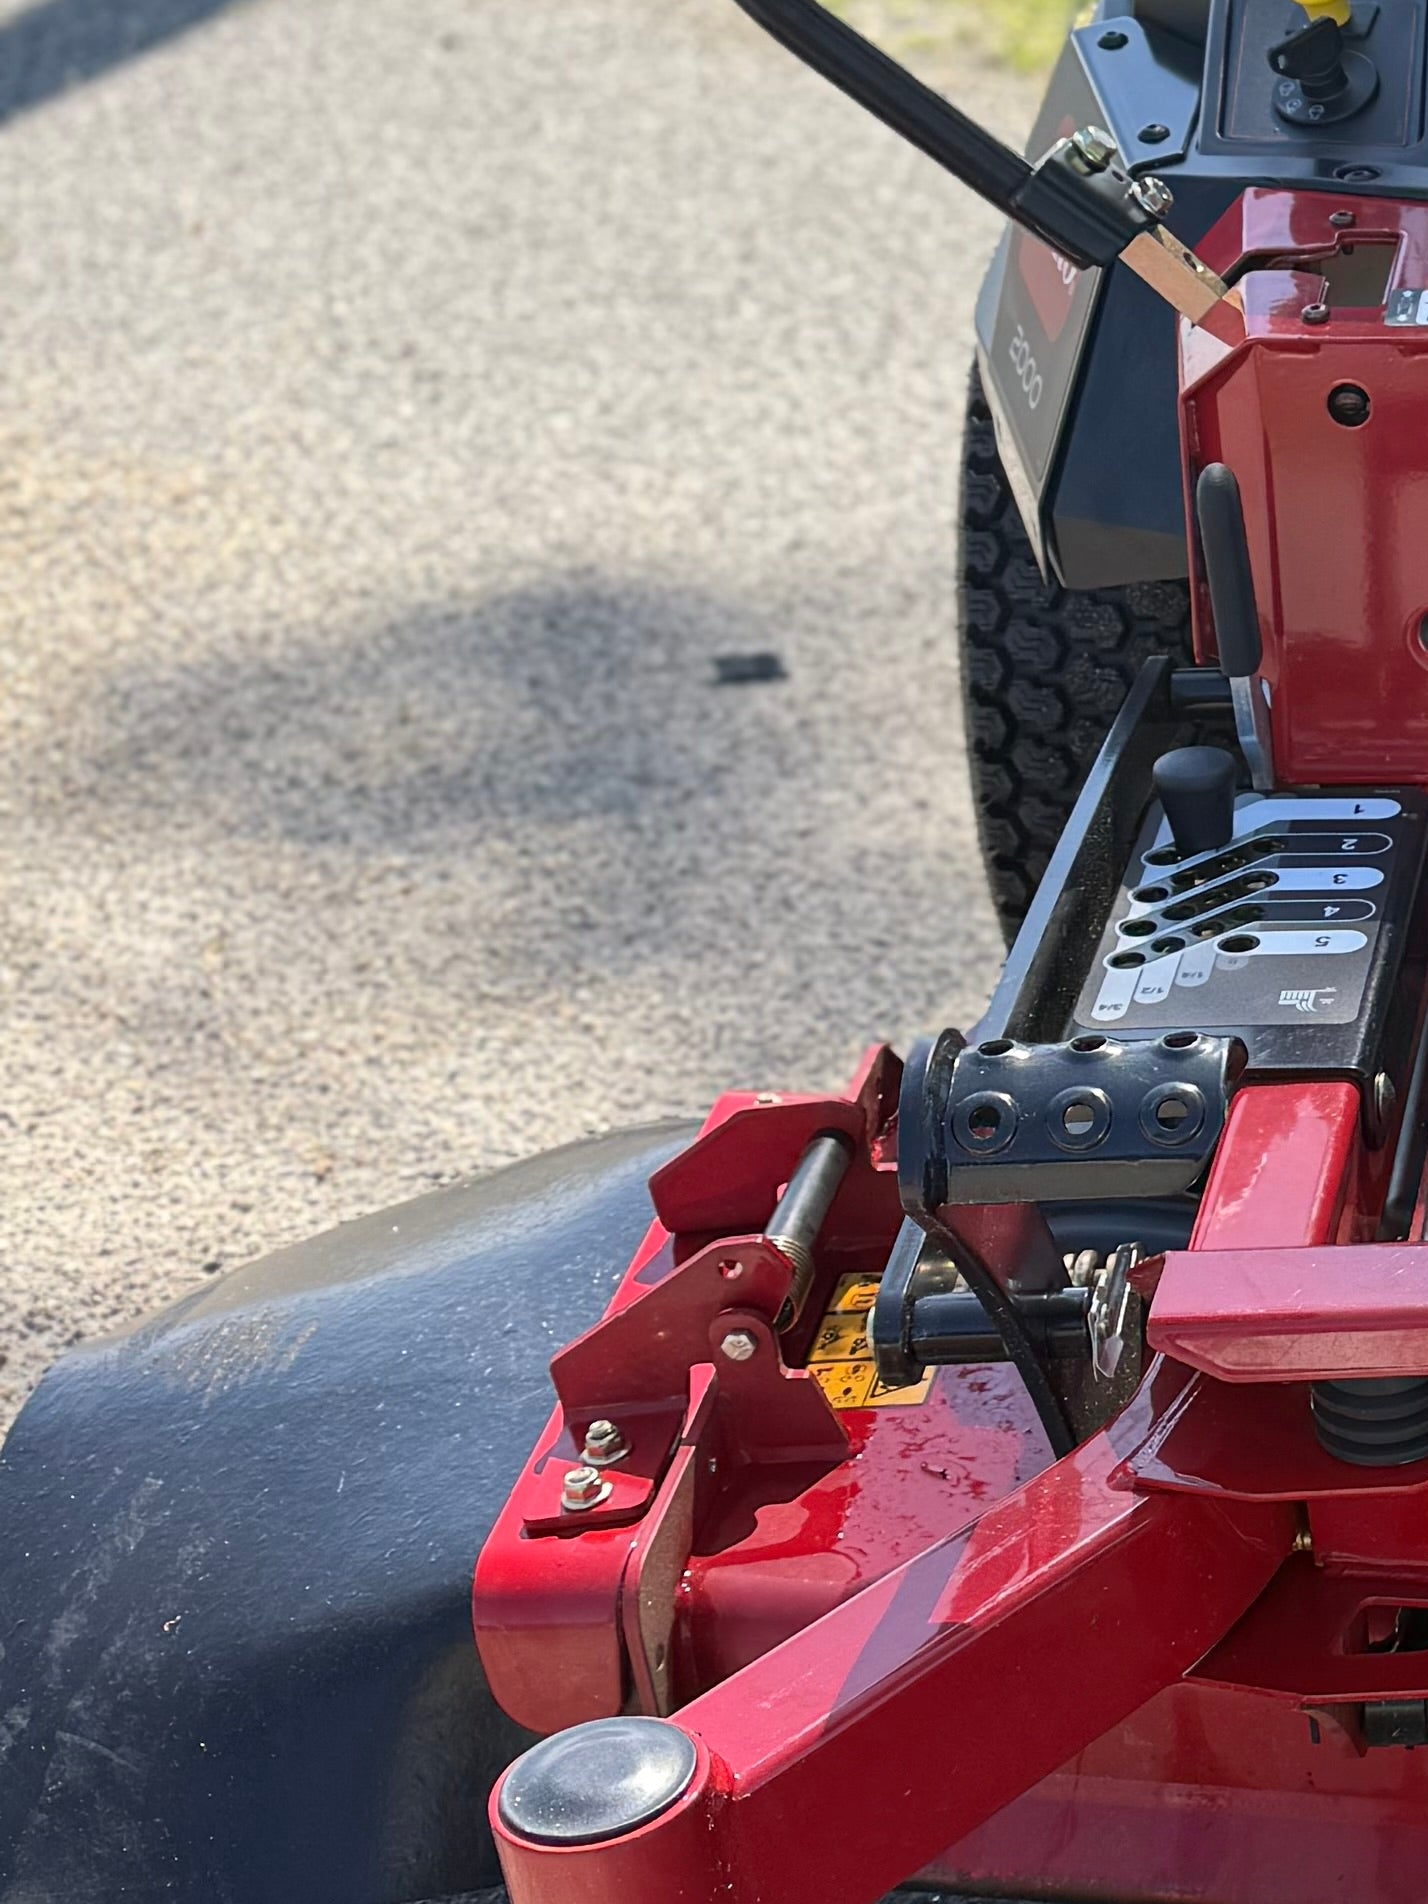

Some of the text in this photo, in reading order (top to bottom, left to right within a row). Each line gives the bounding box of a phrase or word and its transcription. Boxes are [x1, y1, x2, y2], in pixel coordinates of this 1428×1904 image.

[1008, 324, 1043, 411] 2000
[1352, 802, 1366, 815] 1
[1340, 837, 1359, 851] 2
[1331, 872, 1349, 886] 3
[1322, 904, 1341, 918] 4
[1314, 935, 1332, 948] 5
[1139, 985, 1166, 995] 1/2
